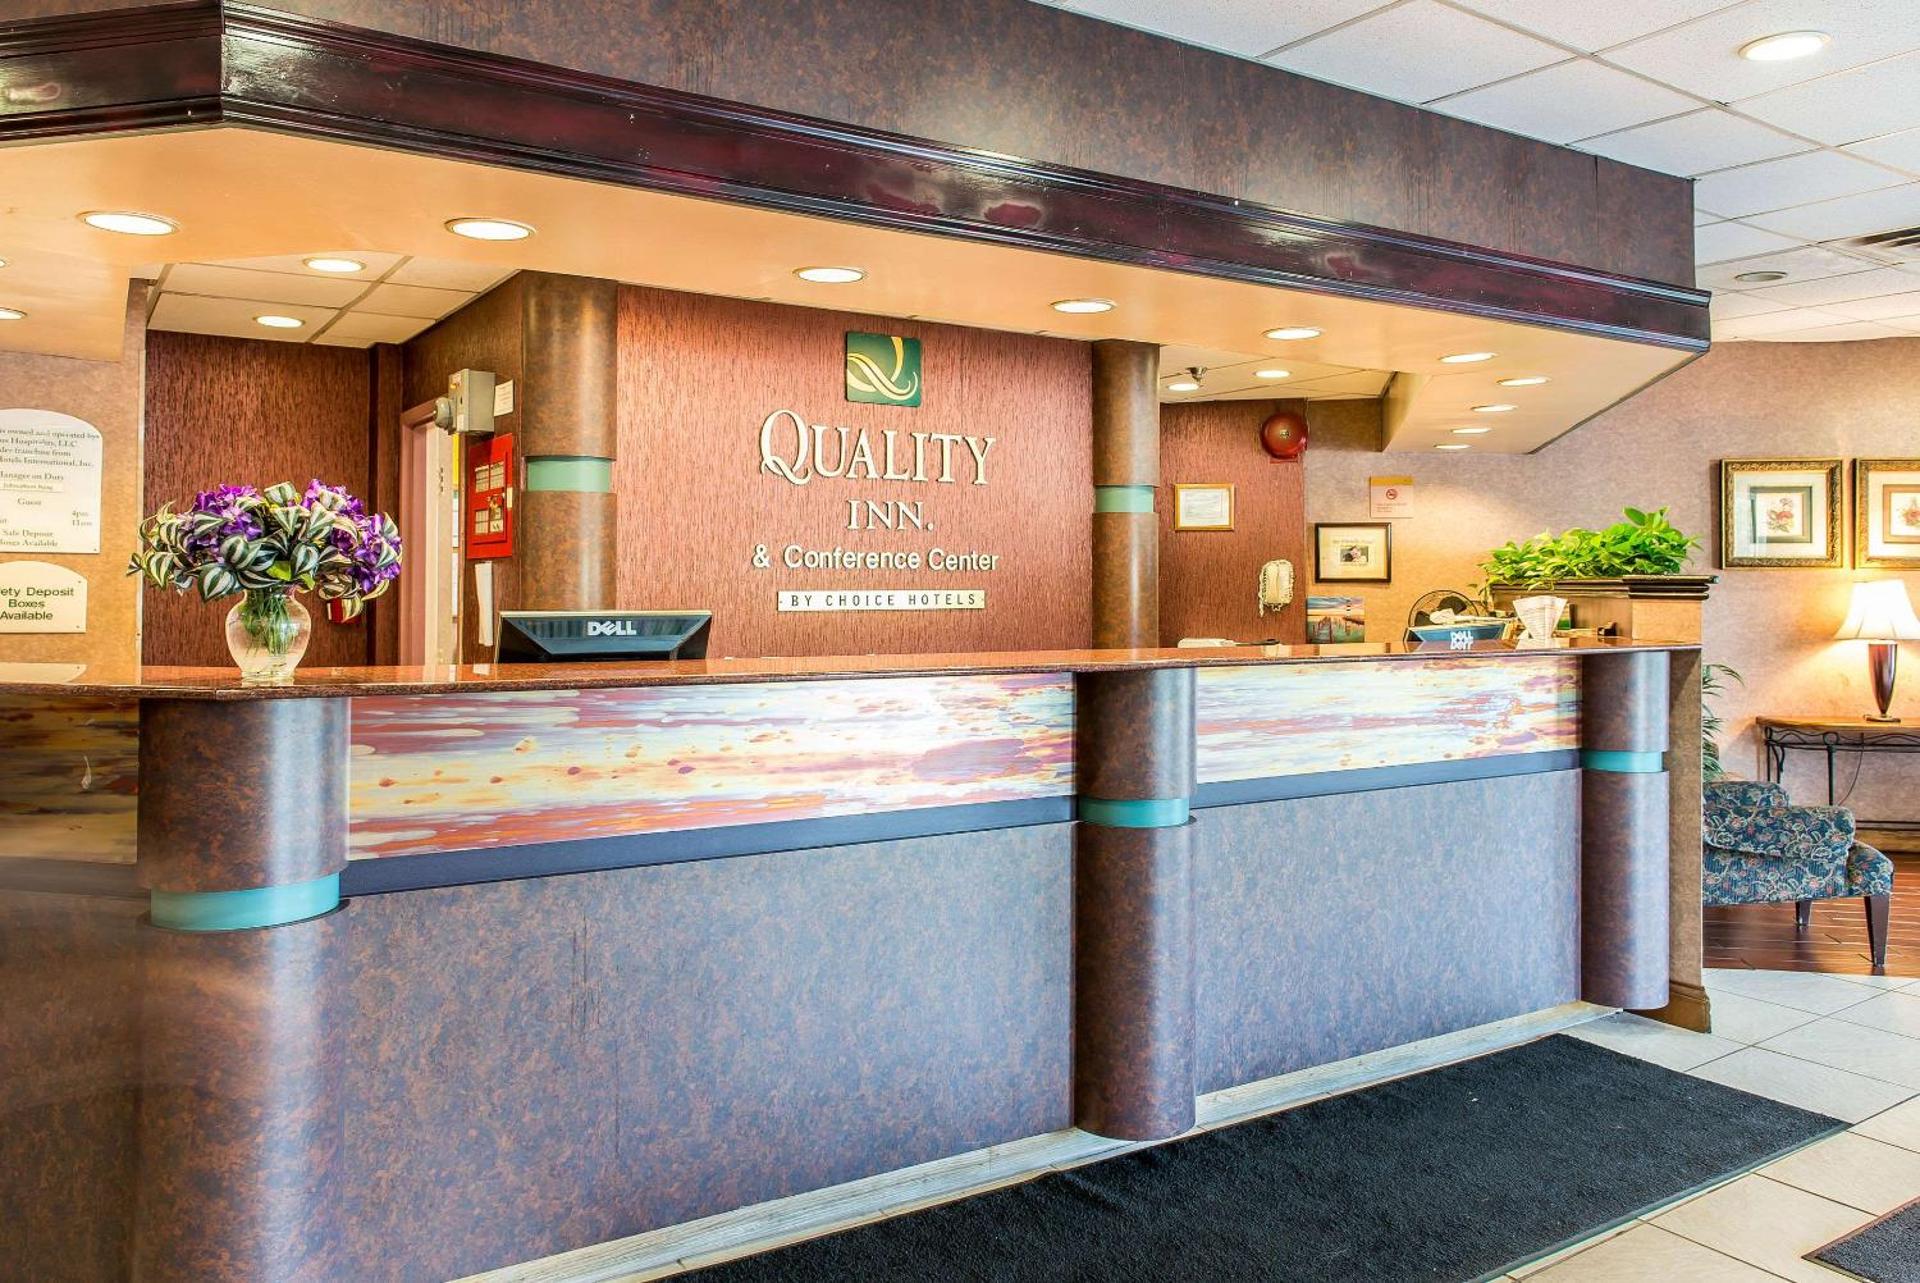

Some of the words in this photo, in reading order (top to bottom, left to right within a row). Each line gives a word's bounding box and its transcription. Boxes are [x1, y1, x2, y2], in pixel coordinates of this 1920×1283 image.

[759, 409, 996, 485] QUALITY
[22, 529, 53, 538] Deposit
[752, 544, 770, 569] &
[784, 545, 920, 570] Conference
[927, 548, 999, 571] Center
[0, 587, 21, 598] ety
[26, 587, 74, 598] Deposit
[8, 599, 45, 608] Boxes
[791, 595, 812, 607] BY
[826, 594, 896, 607] CHOICE
[908, 593, 976, 607] HOTELS
[0, 611, 54, 620] Available
[587, 621, 637, 636] DELL
